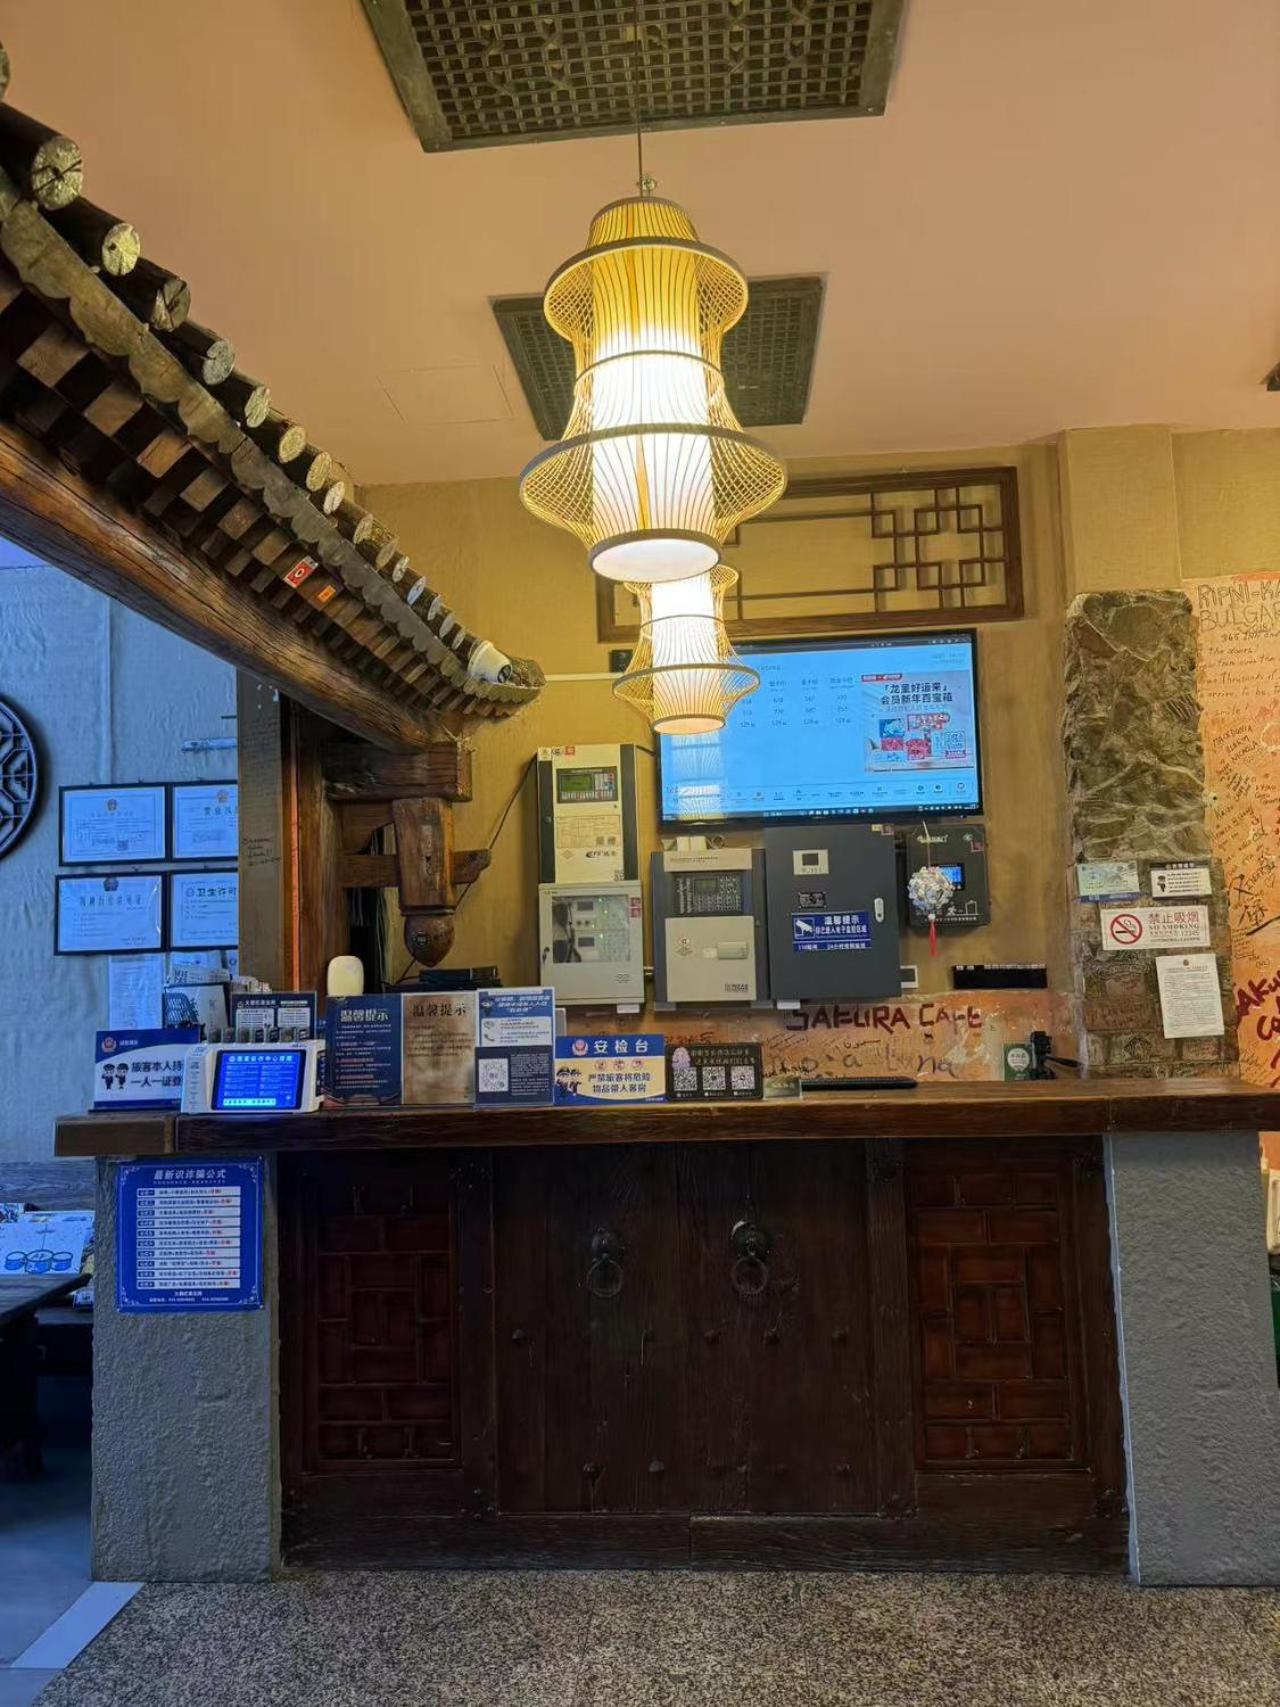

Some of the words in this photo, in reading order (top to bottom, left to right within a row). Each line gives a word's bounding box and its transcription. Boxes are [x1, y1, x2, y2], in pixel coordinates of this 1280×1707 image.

[1195, 581, 1280, 609] RIPNI-K
[204, 806, 238, 816] 营业执
[1148, 911, 1199, 924] 禁止吸烟
[340, 1009, 390, 1022] 温馨提示
[412, 1002, 467, 1018] 温馨提示
[786, 1004, 911, 1035] SAKURA
[594, 1039, 648, 1054] 安检台
